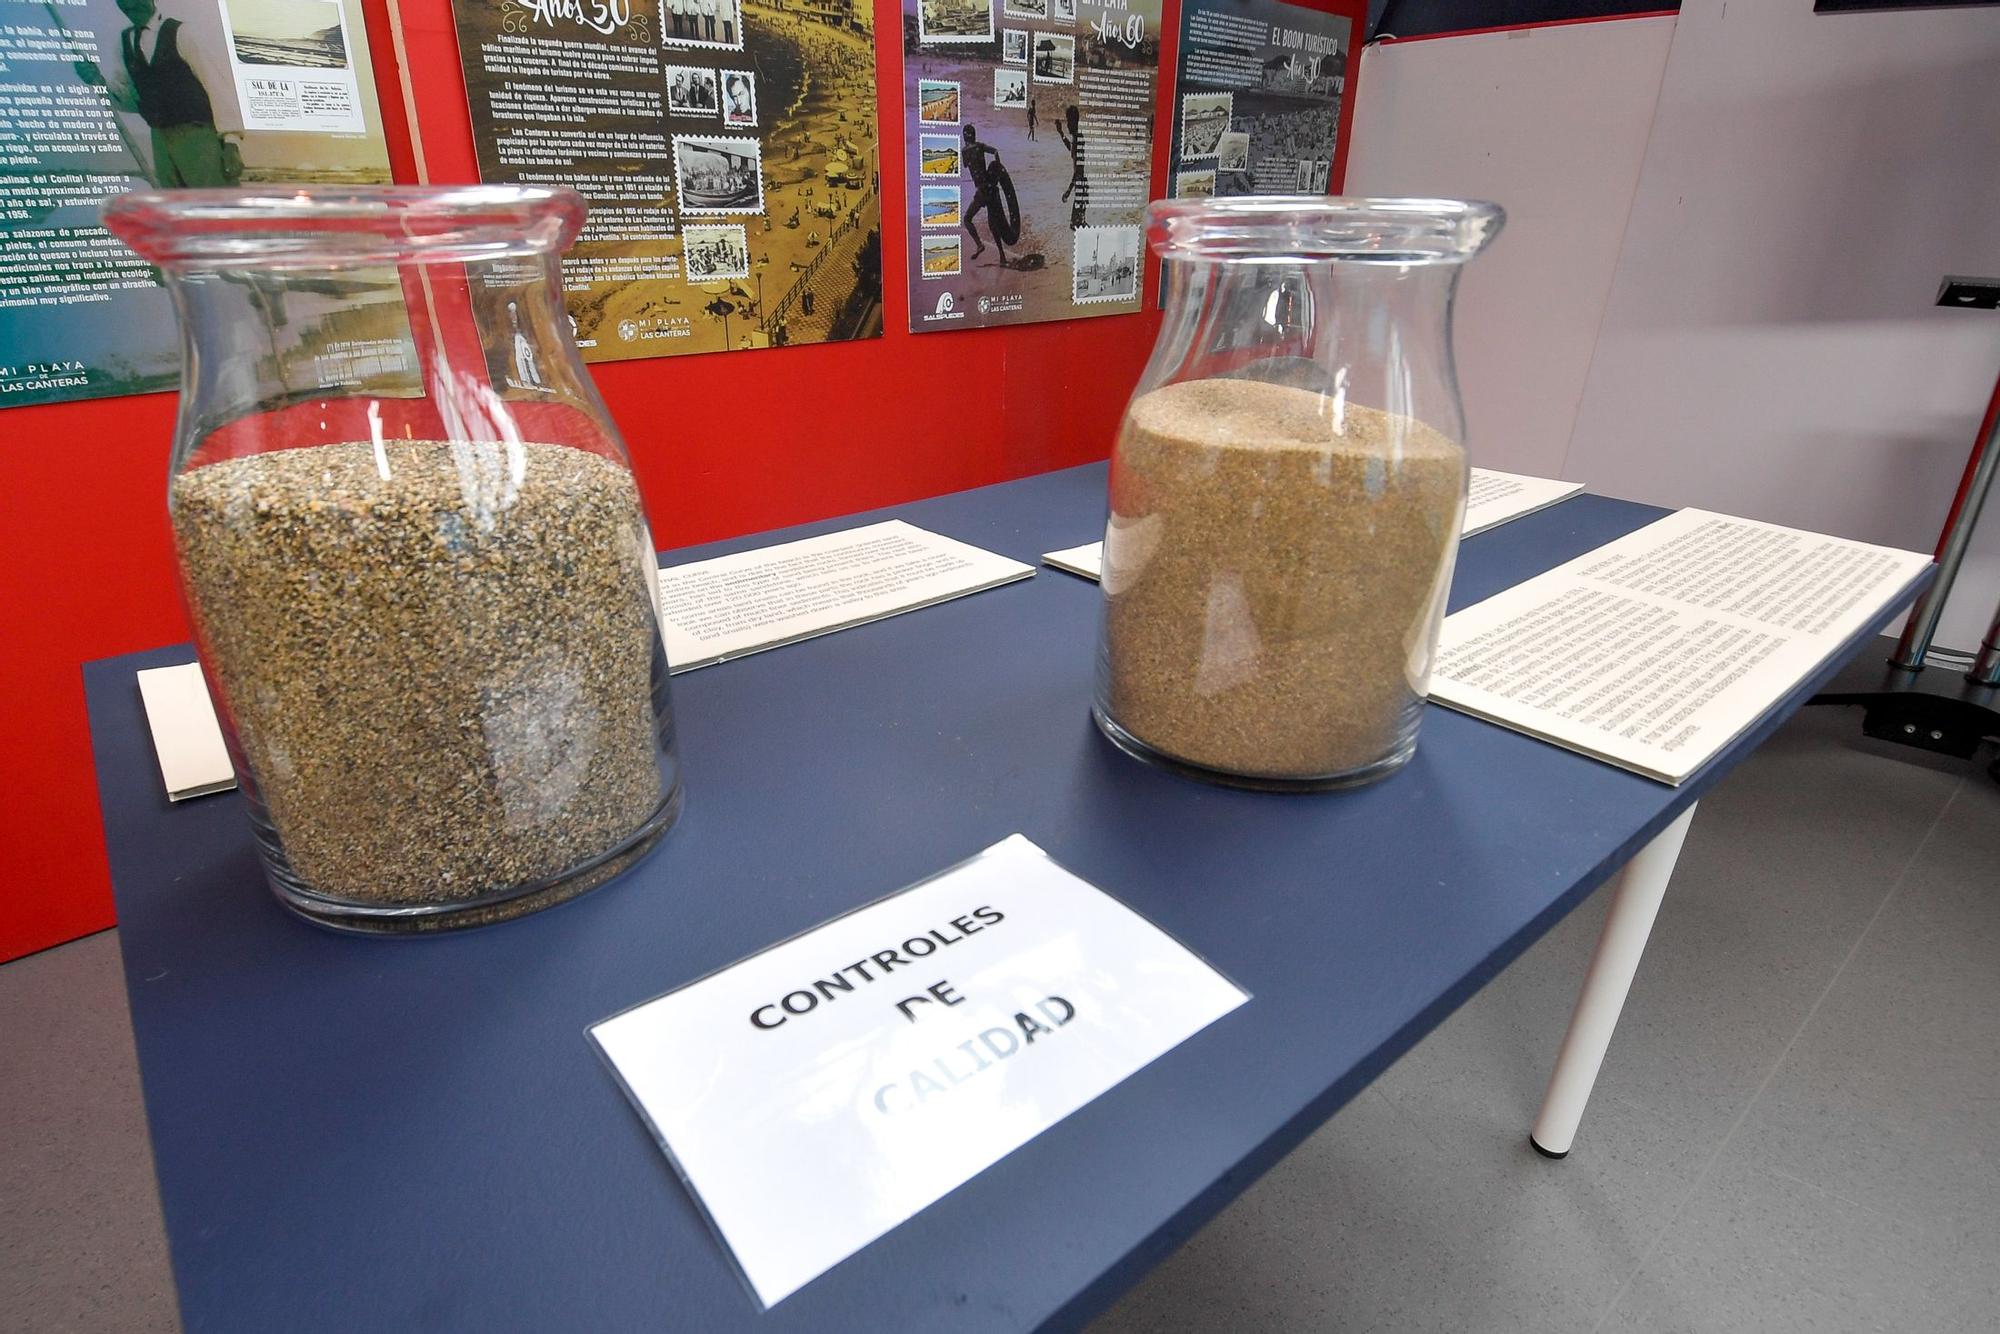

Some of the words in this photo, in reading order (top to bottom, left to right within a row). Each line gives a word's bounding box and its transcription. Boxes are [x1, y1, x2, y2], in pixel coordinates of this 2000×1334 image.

[1091, 11, 1129, 47] Años
[1126, 14, 1144, 43] 60
[62, 41, 98, 50] salinero
[497, 34, 528, 45] Finalizada
[530, 38, 536, 46] la
[538, 39, 562, 48] segunda
[564, 42, 582, 50] guerra
[584, 42, 609, 52] mundial,
[1272, 27, 1280, 45] EL
[1282, 29, 1302, 49] BOOM
[1304, 31, 1338, 56] TURÍSTICO
[60, 54, 84, 62] como
[86, 54, 100, 62] las
[482, 44, 502, 52] tráfico
[504, 46, 530, 54] marítimo
[532, 47, 538, 55] el
[539, 48, 561, 56] turismo
[562, 50, 581, 58] vuelve
[582, 53, 596, 61] poco
[484, 54, 506, 64] gracias
[522, 58, 550, 66] cruceros.
[552, 58, 556, 66] A
[558, 59, 572, 68] final
[572, 60, 580, 68] de
[582, 60, 586, 68] la
[588, 62, 608, 70] década
[608, 64, 634, 72] comienza
[1284, 53, 1311, 82] Años
[485, 65, 510, 74] realidad
[519, 67, 541, 76] llegada
[551, 69, 572, 78] turistas
[574, 72, 582, 80] por
[594, 72, 612, 80] aérea.
[68, 86, 90, 94] siglo
[92, 86, 108, 94] XIX
[251, 80, 264, 90] SAL
[268, 82, 276, 90] DE
[280, 82, 289, 91] LA
[15, 97, 52, 106] pequeña
[8, 108, 20, 116] de
[54, 108, 84, 117] extraía
[48, 120, 60, 128] de
[98, 122, 103, 130] y
[26, 134, 30, 142] y
[32, 132, 72, 140] circulaba
[82, 132, 106, 140] través
[109, 132, 120, 140] de
[524, 128, 550, 137] Canteras
[5, 144, 33, 154] riego,
[52, 144, 90, 154] acequias
[90, 145, 96, 154] y
[98, 144, 122, 152] caños
[10, 156, 41, 165] piedra.
[33, 175, 48, 183] del
[50, 175, 84, 184] Confital
[86, 174, 120, 184] llegaron
[12, 187, 39, 196] media
[41, 187, 90, 196] aproximada
[92, 186, 102, 194] de
[104, 186, 119, 194] 120
[8, 198, 24, 207] año
[26, 199, 37, 208] de
[39, 198, 55, 208] sal,
[58, 200, 62, 208] y
[7, 211, 32, 220] 1956.
[14, 229, 56, 238] salazones
[60, 228, 70, 236] de
[74, 228, 112, 238] pescado,
[6, 242, 36, 252] pieles,
[38, 240, 47, 248] el
[50, 240, 88, 248] consumo
[28, 252, 38, 260] de
[41, 252, 70, 262] quesos
[80, 250, 108, 258] incluso
[110, 248, 122, 258] los
[72, 261, 94, 270] traen
[105, 260, 113, 268] la
[30, 273, 63, 283] salinas,
[66, 273, 81, 281] una
[84, 270, 120, 280] industria
[122, 269, 154, 279] ecológi-
[22, 286, 42, 295] bien
[44, 284, 90, 294] etnográfico
[92, 282, 108, 290] con
[110, 282, 120, 290] un
[122, 280, 156, 289] atractivo
[40, 297, 58, 306] muy
[59, 294, 112, 305] significativo.
[658, 318, 690, 326] PLAYA
[655, 330, 690, 338] CANTERAS
[0, 367, 17, 376] MI
[28, 361, 84, 374] PLAYA
[2, 382, 24, 392] LAS
[26, 376, 89, 390] CANTERAS
[725, 573, 776, 586] sedimentary
[749, 906, 1006, 1030] CONTROLES
[895, 980, 966, 1024] DE
[873, 996, 1076, 1115] CALIDAD
